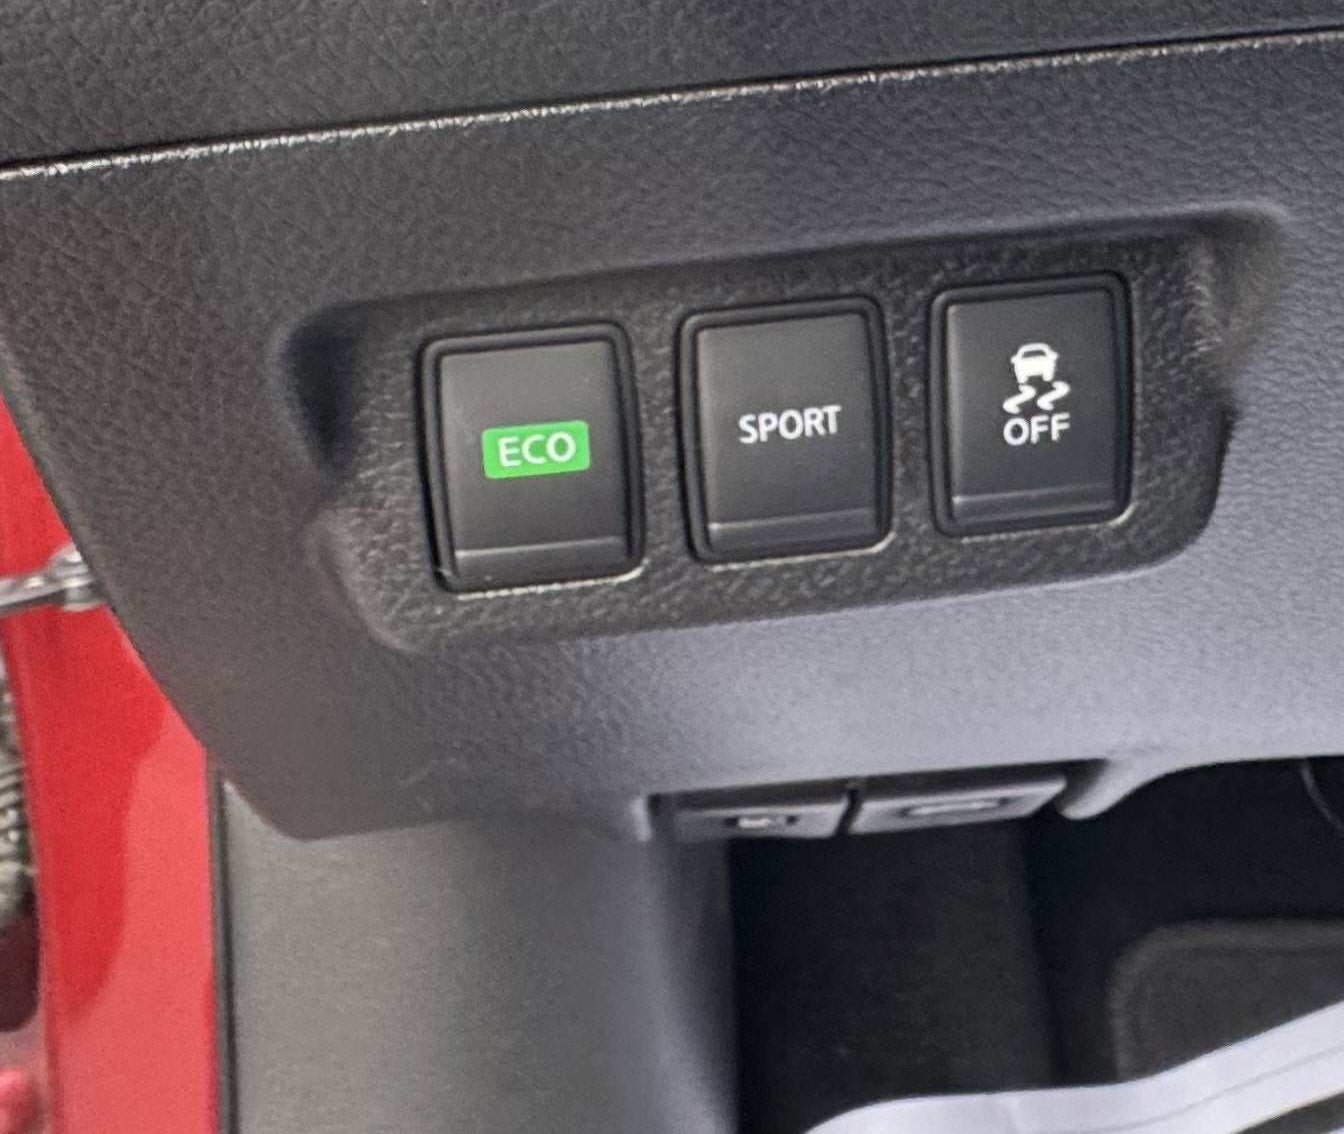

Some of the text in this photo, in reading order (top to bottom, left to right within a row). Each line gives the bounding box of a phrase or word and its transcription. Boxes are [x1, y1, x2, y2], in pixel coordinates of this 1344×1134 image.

[737, 404, 843, 445] SPORT
[1002, 412, 1071, 446] OFF
[498, 432, 576, 467] ECO
